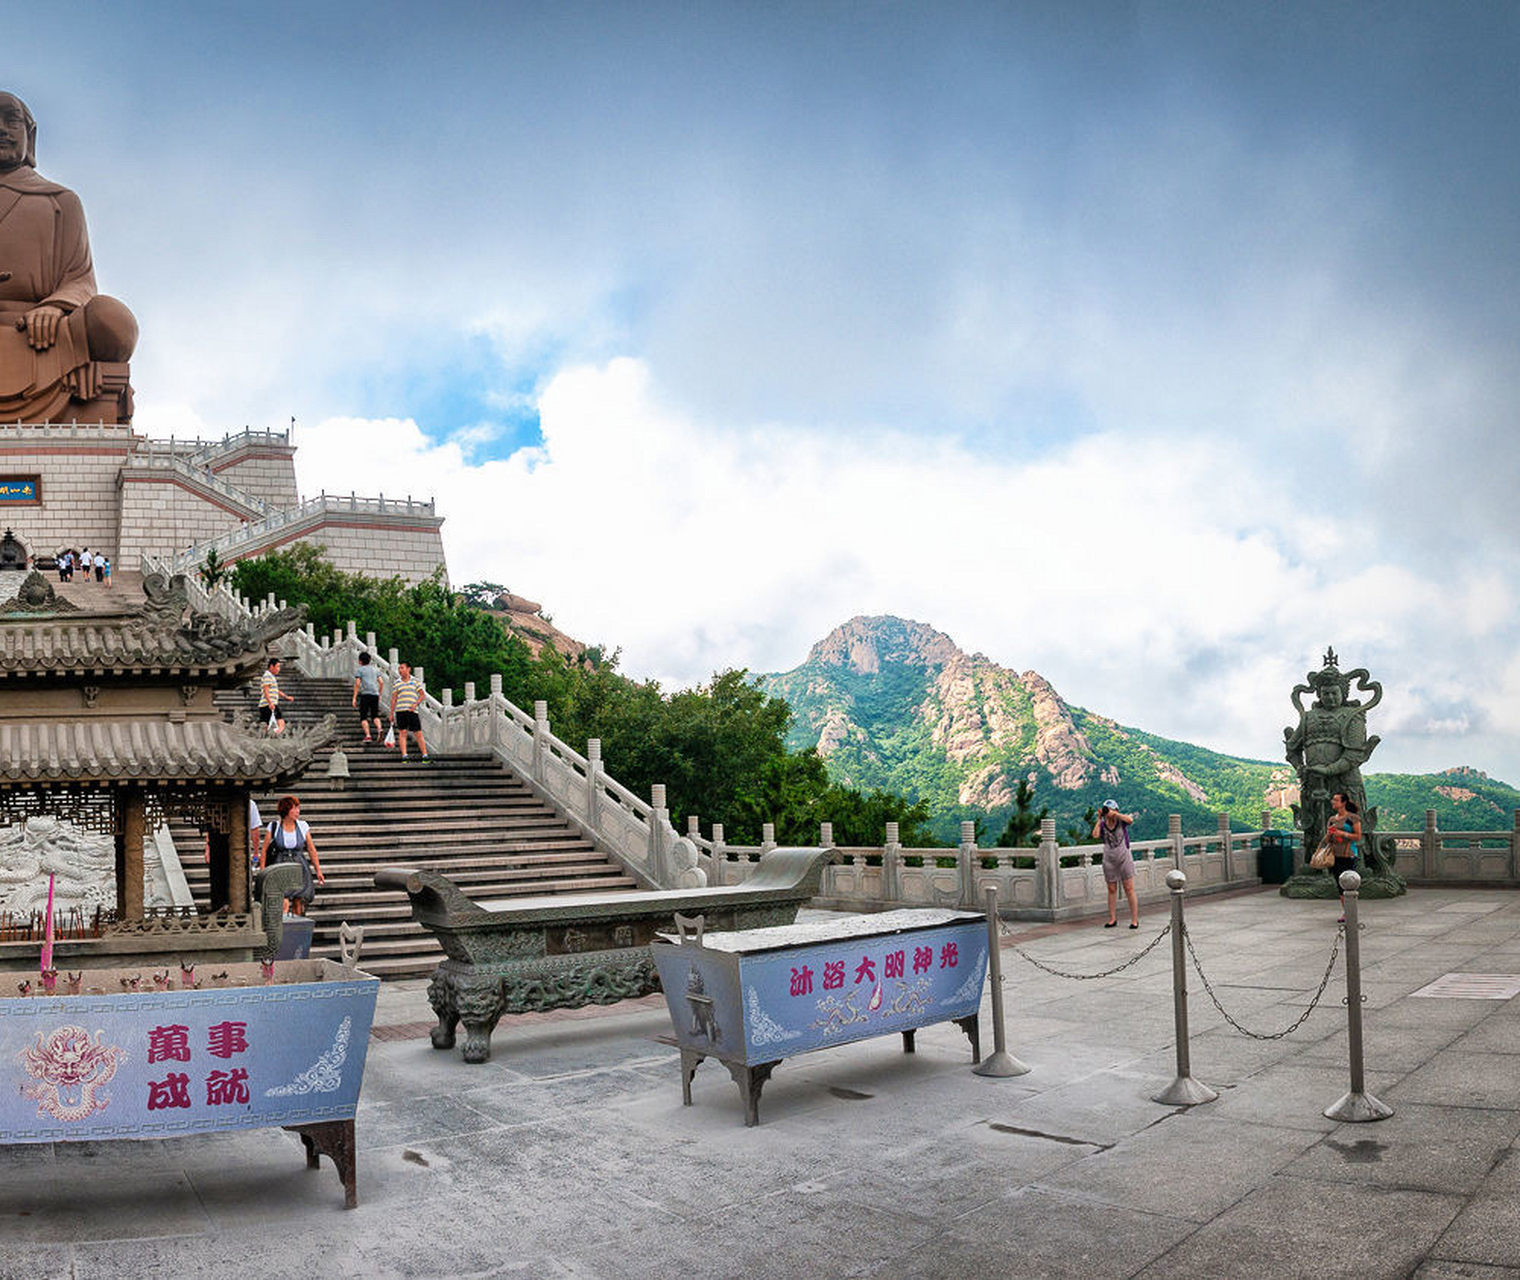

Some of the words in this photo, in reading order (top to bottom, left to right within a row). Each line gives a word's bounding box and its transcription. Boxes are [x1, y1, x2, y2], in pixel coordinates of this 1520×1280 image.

[790, 942, 959, 997] 沐浴大明神光
[147, 1021, 249, 1064] 萬事
[147, 1068, 250, 1110] 成就
